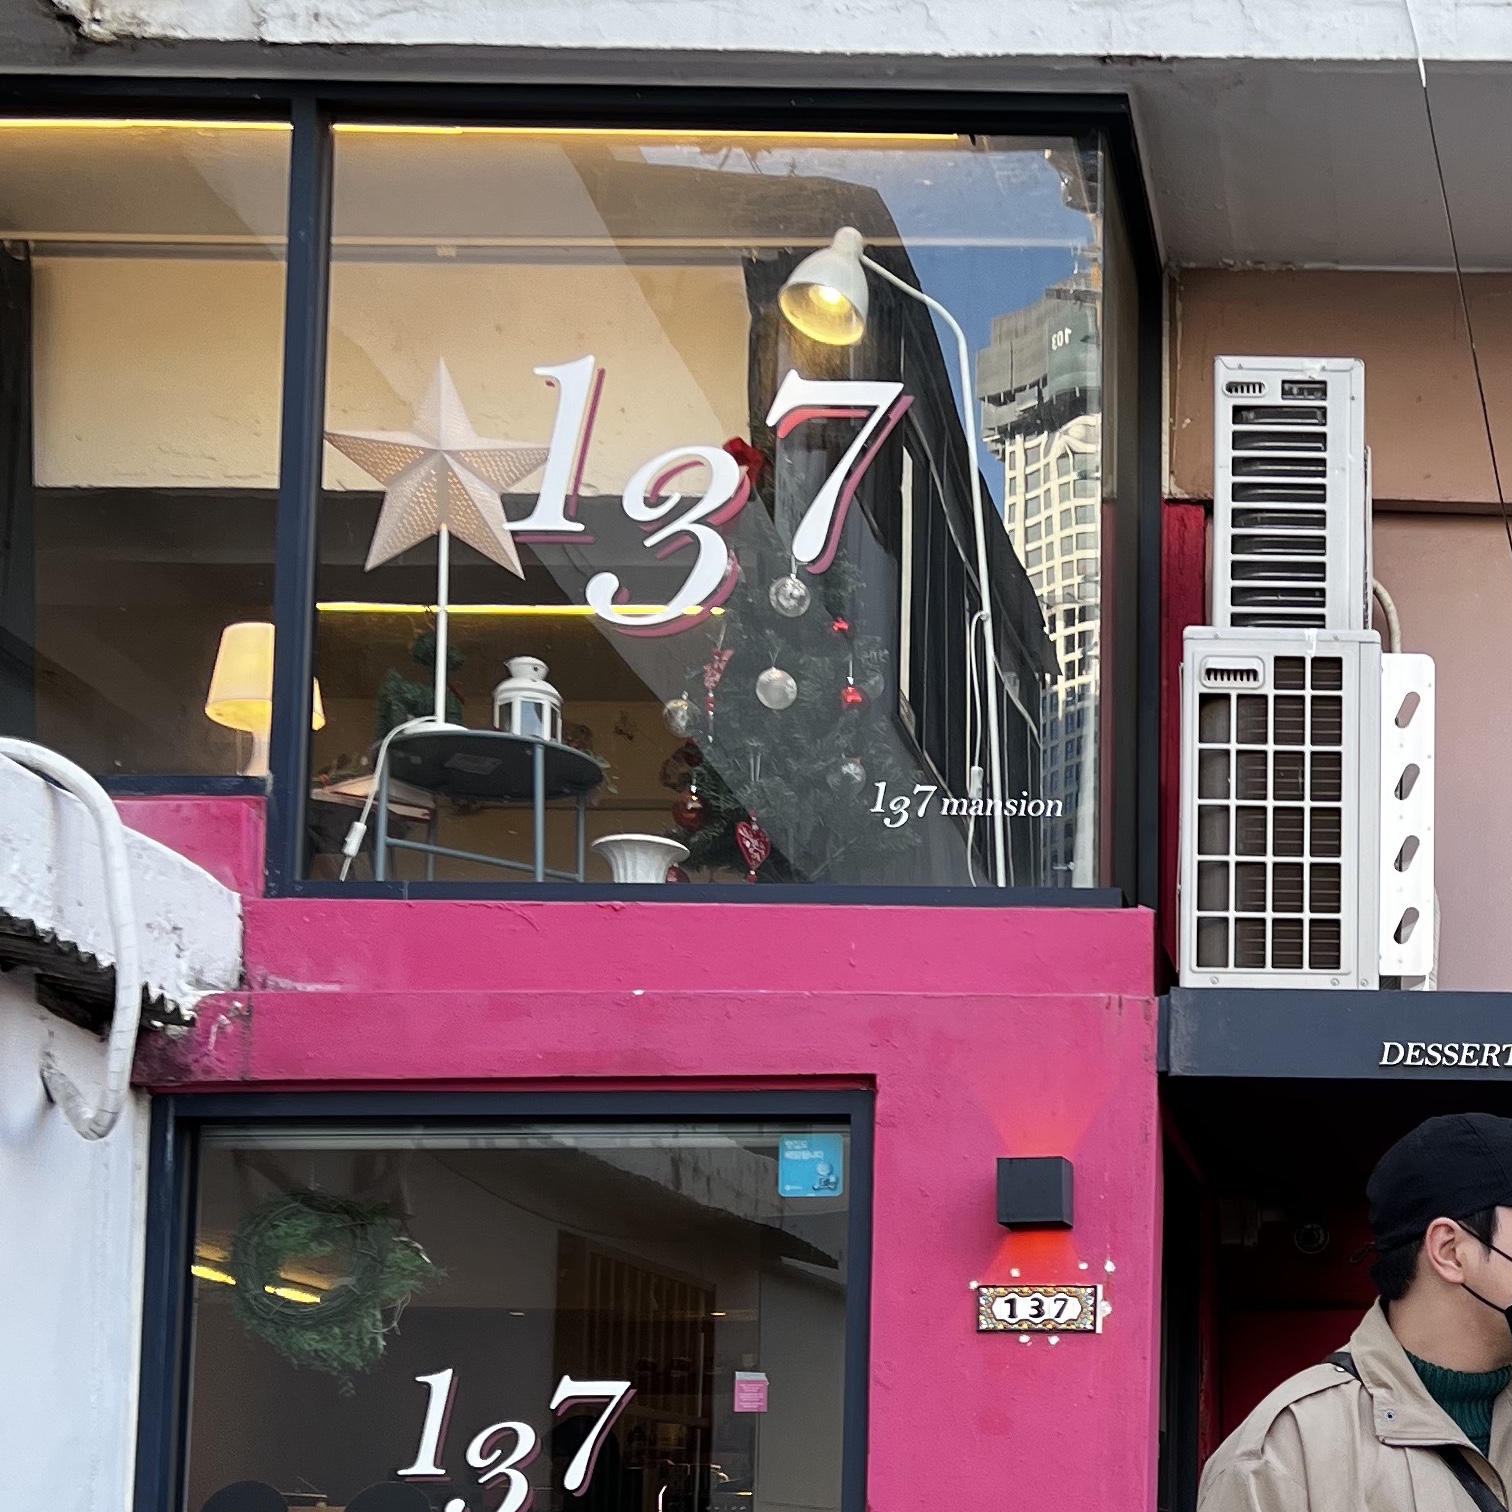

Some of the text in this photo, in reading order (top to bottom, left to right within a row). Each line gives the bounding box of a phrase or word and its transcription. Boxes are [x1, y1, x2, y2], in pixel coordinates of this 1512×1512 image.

[502, 354, 912, 635] 137
[869, 781, 1063, 829] 137 mansion
[1003, 1297, 1069, 1319] 137
